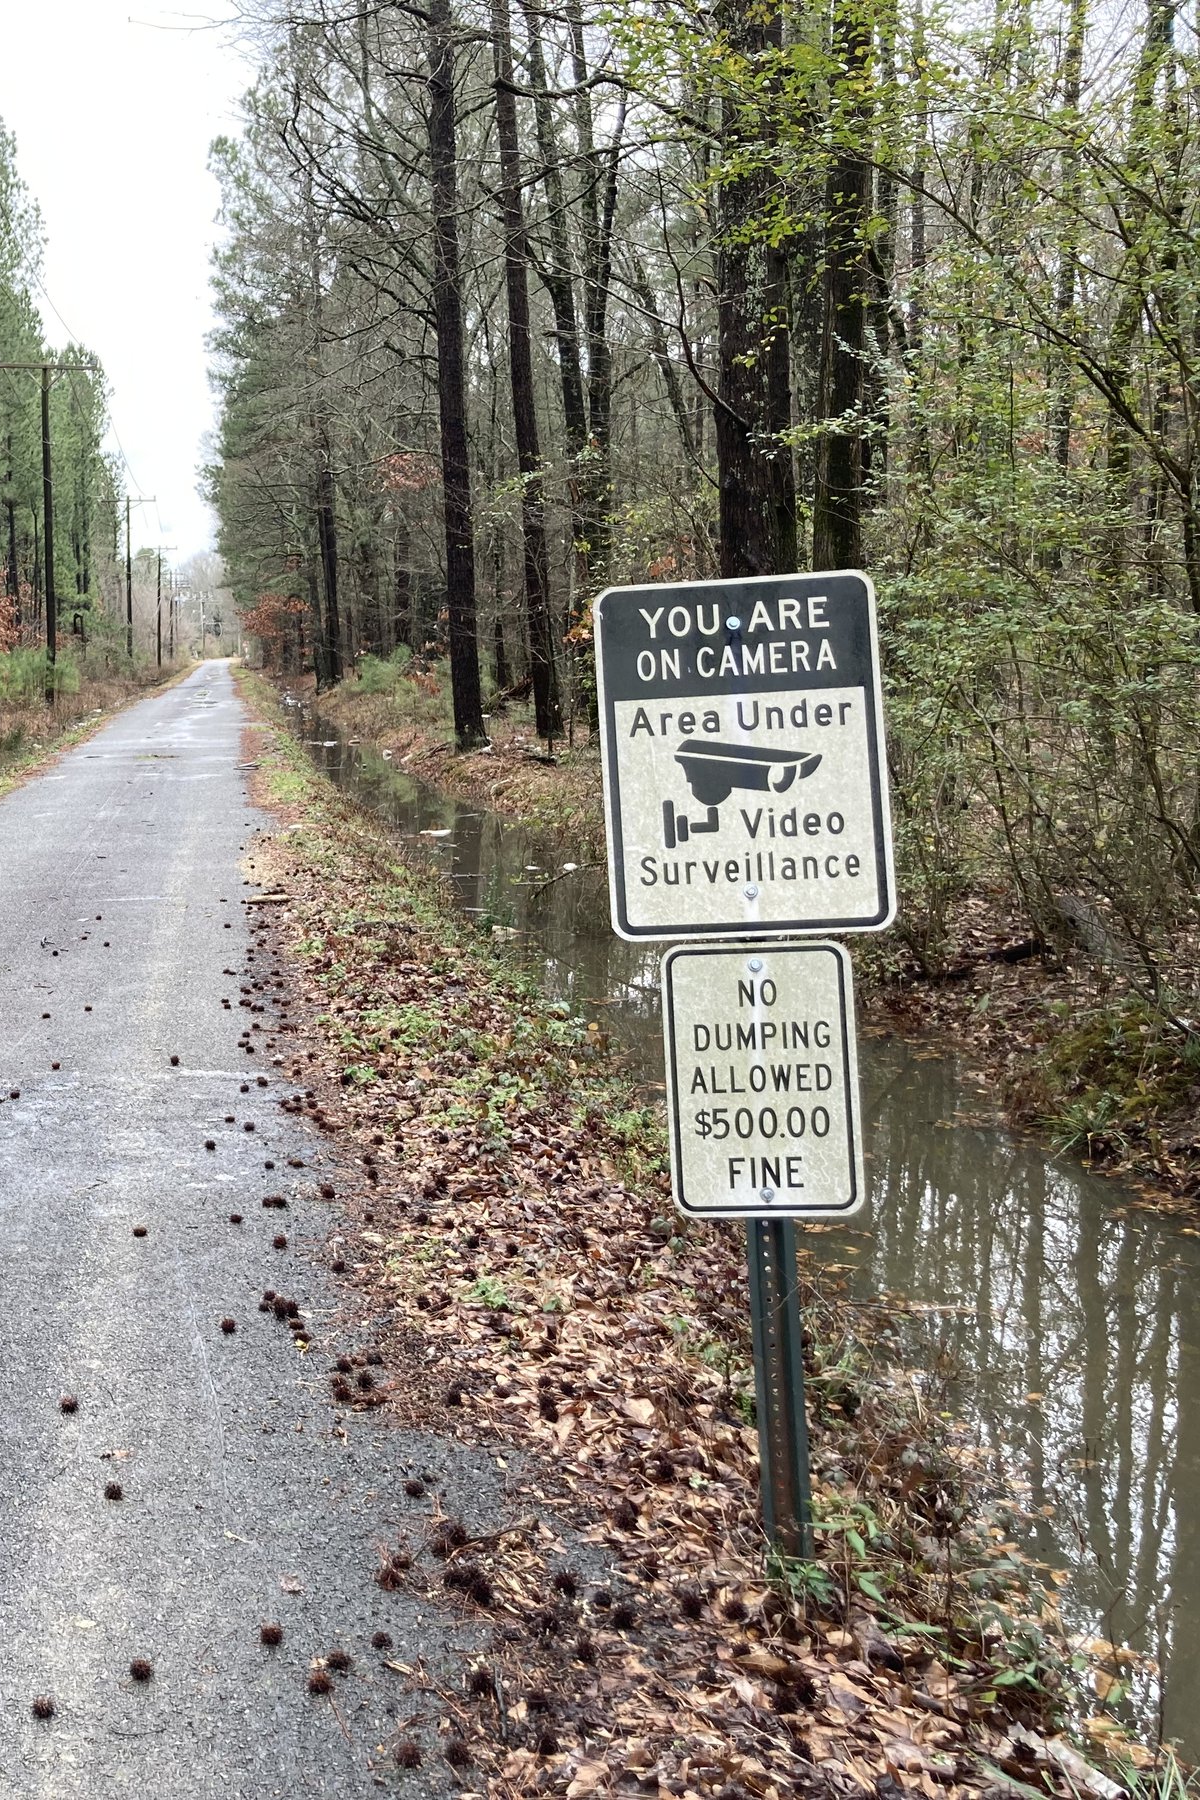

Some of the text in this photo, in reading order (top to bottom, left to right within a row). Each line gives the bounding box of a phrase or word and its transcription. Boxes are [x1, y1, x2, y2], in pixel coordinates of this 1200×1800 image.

[638, 596, 831, 640] YOU ARE
[636, 638, 837, 682] ON CAMERA
[629, 698, 852, 738] Area Under
[739, 807, 845, 839] Video
[640, 851, 861, 887] Surveillance
[737, 978, 777, 1007] NO
[693, 1020, 831, 1052] DUMPING
[690, 1063, 832, 1094] ALLOWED
[694, 1106, 830, 1139] $500.00
[728, 1156, 804, 1189] FINE
